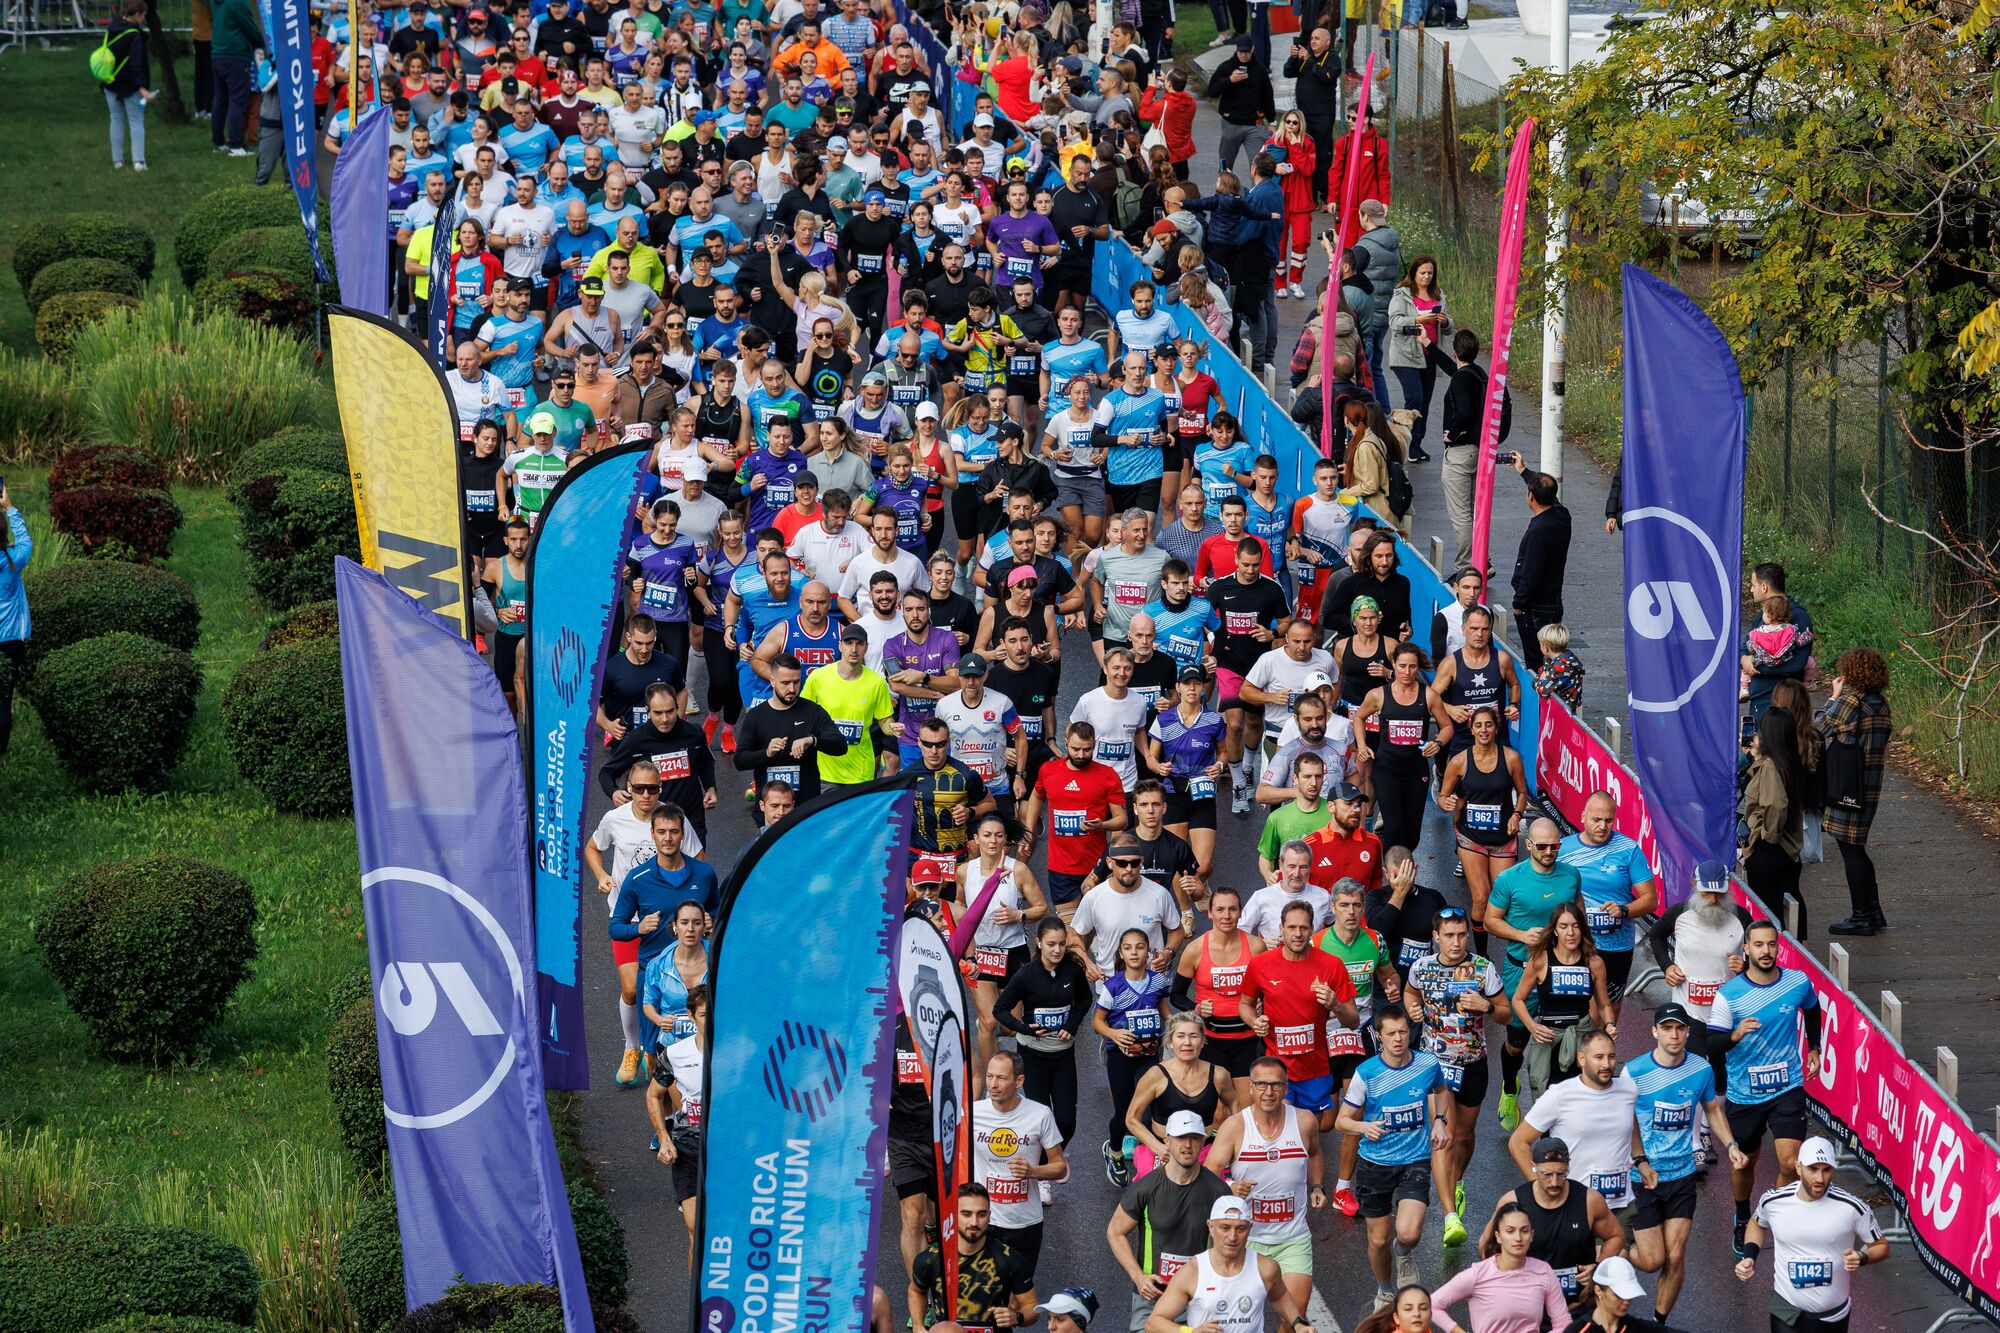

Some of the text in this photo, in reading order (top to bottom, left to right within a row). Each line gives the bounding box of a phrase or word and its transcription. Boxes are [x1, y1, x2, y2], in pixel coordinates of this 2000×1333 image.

[942, 225, 958, 234] 1095
[863, 260, 876, 268] 989
[1013, 262, 1026, 272] 843
[460, 286, 475, 296] 1160
[1016, 361, 1028, 370] 818
[899, 391, 914, 400] 1271
[815, 410, 829, 419] 932
[630, 428, 647, 438] 2276
[1073, 431, 1089, 441] 1237
[774, 492, 789, 501] 988
[1215, 489, 1232, 498] 1214
[471, 496, 489, 505] 1046
[899, 526, 912, 536] 987
[652, 590, 667, 601] 888
[1120, 587, 1140, 597] 1530
[1232, 617, 1251, 628] 1529
[1175, 644, 1191, 655] 1319
[794, 647, 836, 665] NETS
[905, 655, 918, 664] 5G
[1464, 687, 1497, 697] SAYSKY
[1396, 727, 1416, 738] 1633
[954, 739, 997, 752] Slovenia
[1106, 744, 1123, 754] 1317
[660, 759, 682, 773] 2214
[775, 774, 791, 784] 938
[1199, 782, 1214, 792] 808
[548, 729, 558, 874] PODGORICA
[556, 720, 567, 877] MILLENNIUM
[1475, 811, 1492, 822] 962
[1060, 818, 1077, 828] 1311
[1595, 913, 1614, 926] 1159
[977, 954, 999, 966] 2189
[1219, 974, 1242, 987] 2109
[1560, 974, 1583, 986] 1089
[1695, 985, 1718, 998] 2155
[1044, 1014, 1063, 1028] 994
[1136, 1016, 1154, 1029] 995
[1284, 1033, 1308, 1047] 2110
[1336, 1034, 1357, 1048] 2167
[1758, 1071, 1780, 1085] 1071
[1395, 1111, 1413, 1123] 941
[1663, 1109, 1686, 1123] 1124
[977, 1131, 1030, 1147] Hard Rock
[1920, 1121, 1965, 1231] 5G
[995, 1180, 1020, 1194] 2175
[1600, 1176, 1620, 1189] 1031
[1261, 1200, 1286, 1214] 2161
[707, 1235, 733, 1289] NLB
[1797, 1264, 1822, 1278] 1142
[1940, 1264, 1961, 1288] MAYER
